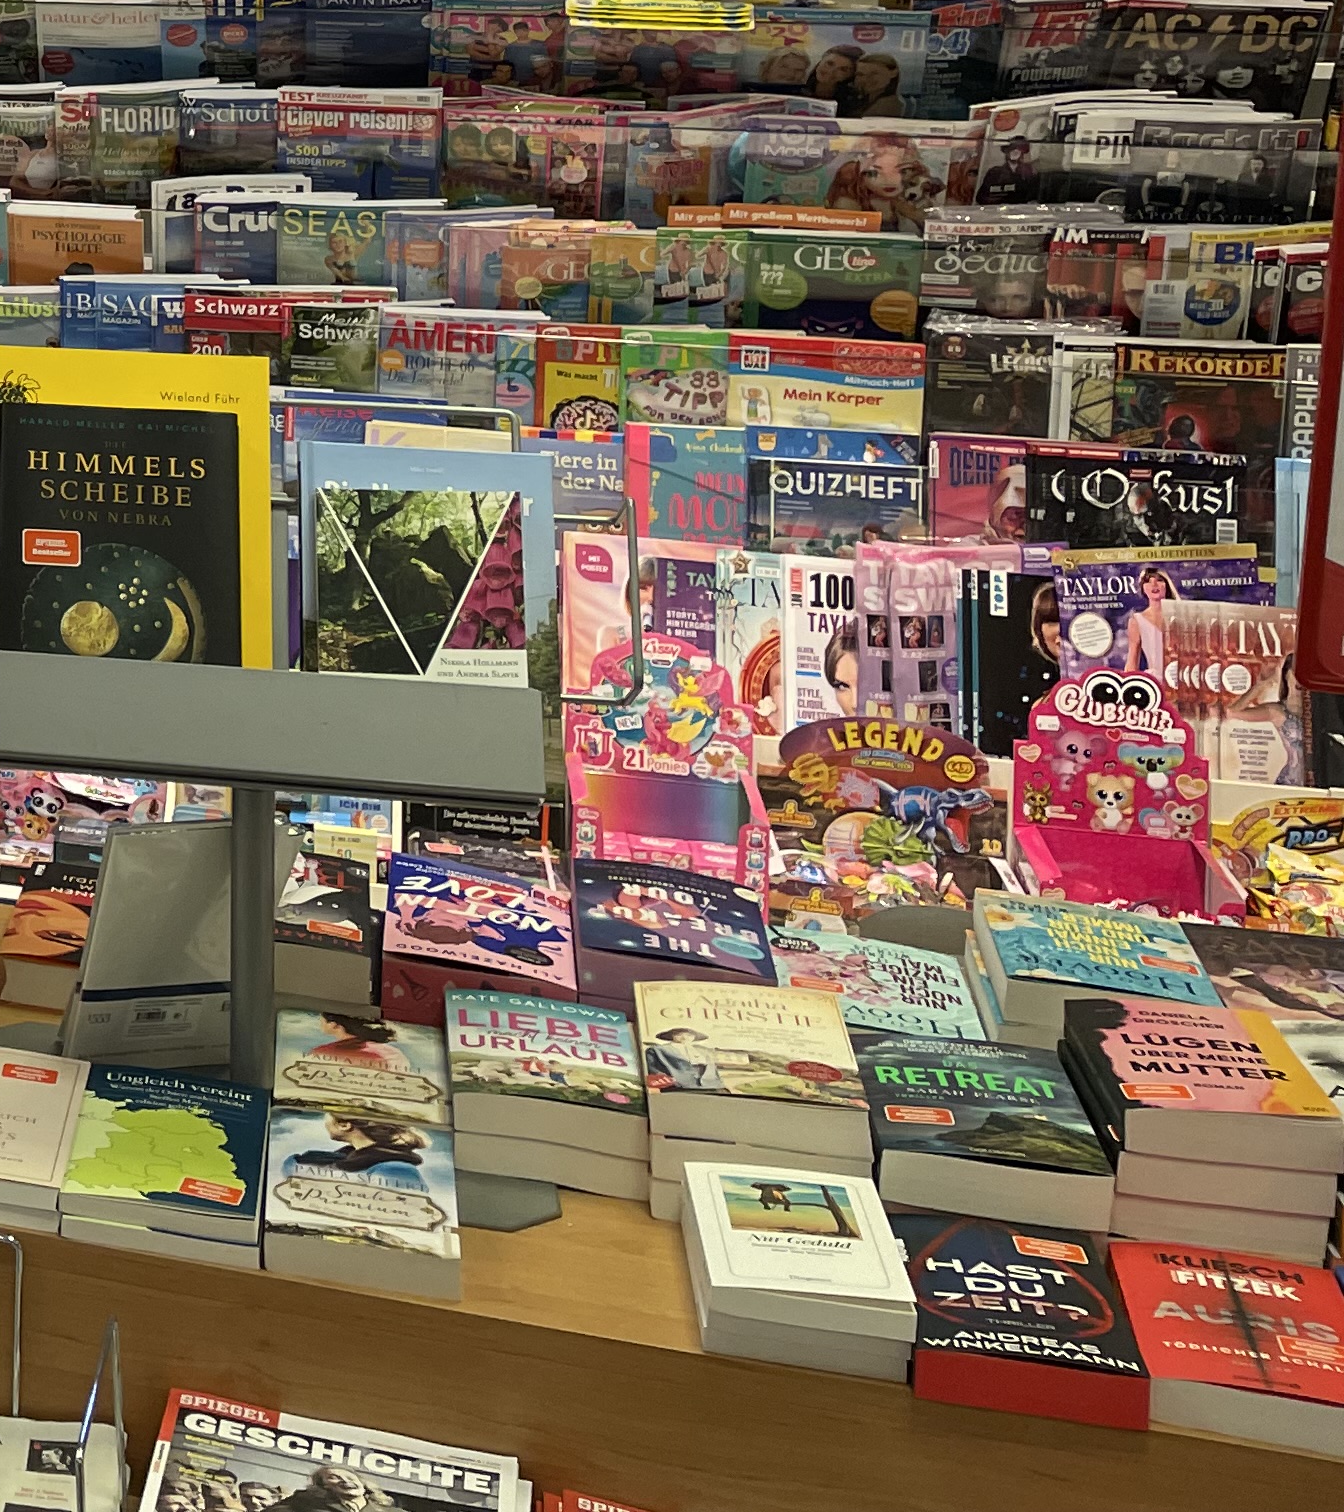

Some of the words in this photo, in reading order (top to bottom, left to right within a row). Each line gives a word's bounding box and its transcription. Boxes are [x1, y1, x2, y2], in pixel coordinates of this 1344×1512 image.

[728, 210, 750, 223] Mit
[752, 212, 794, 224] großem
[796, 214, 868, 227] Wettbewerb!
[31, 229, 126, 245] PSYCHOLOGIE
[159, 391, 210, 403] Wieland
[215, 394, 240, 404] Führ
[783, 388, 832, 404] Mein
[836, 390, 885, 407] Körper
[19, 417, 70, 427] HARALD
[76, 420, 125, 430] MELLER
[137, 423, 160, 431] KAI
[27, 449, 206, 479] HIMMELS
[40, 479, 192, 506] SCHEIBE
[769, 468, 921, 500] QUIZHEFT
[59, 508, 99, 522] VON
[107, 511, 172, 527] NEBRA
[1062, 576, 1137, 596] TAYLOR
[827, 722, 945, 762] LEGEND
[452, 993, 500, 1005] KATE
[509, 997, 620, 1023] GALLOWAY
[1138, 1010, 1209, 1022] DANIELA
[458, 1008, 622, 1047] LIEBE
[1132, 1017, 1225, 1030] DRÖSCHER
[460, 1034, 628, 1068] URLAUB
[1121, 1032, 1262, 1054] LÜGEN
[1131, 1048, 1189, 1059] ÜBER
[1199, 1054, 1269, 1066] MEINE
[874, 1065, 1056, 1099] RETREAT
[1130, 1060, 1290, 1082] MUTTER
[106, 1070, 186, 1088] Ungleich
[186, 1083, 254, 1103] vereint
[924, 1257, 1073, 1286] HAST
[964, 1276, 1046, 1298] DU
[1171, 1269, 1302, 1302] FITZEK
[932, 1291, 1089, 1321] ZEIT?
[923, 1336, 1140, 1373] WINKELMANN
[954, 1330, 1102, 1355] ANDREAS
[178, 1393, 270, 1424] SPIEGEL
[182, 1412, 492, 1494] GESCHICHTE
